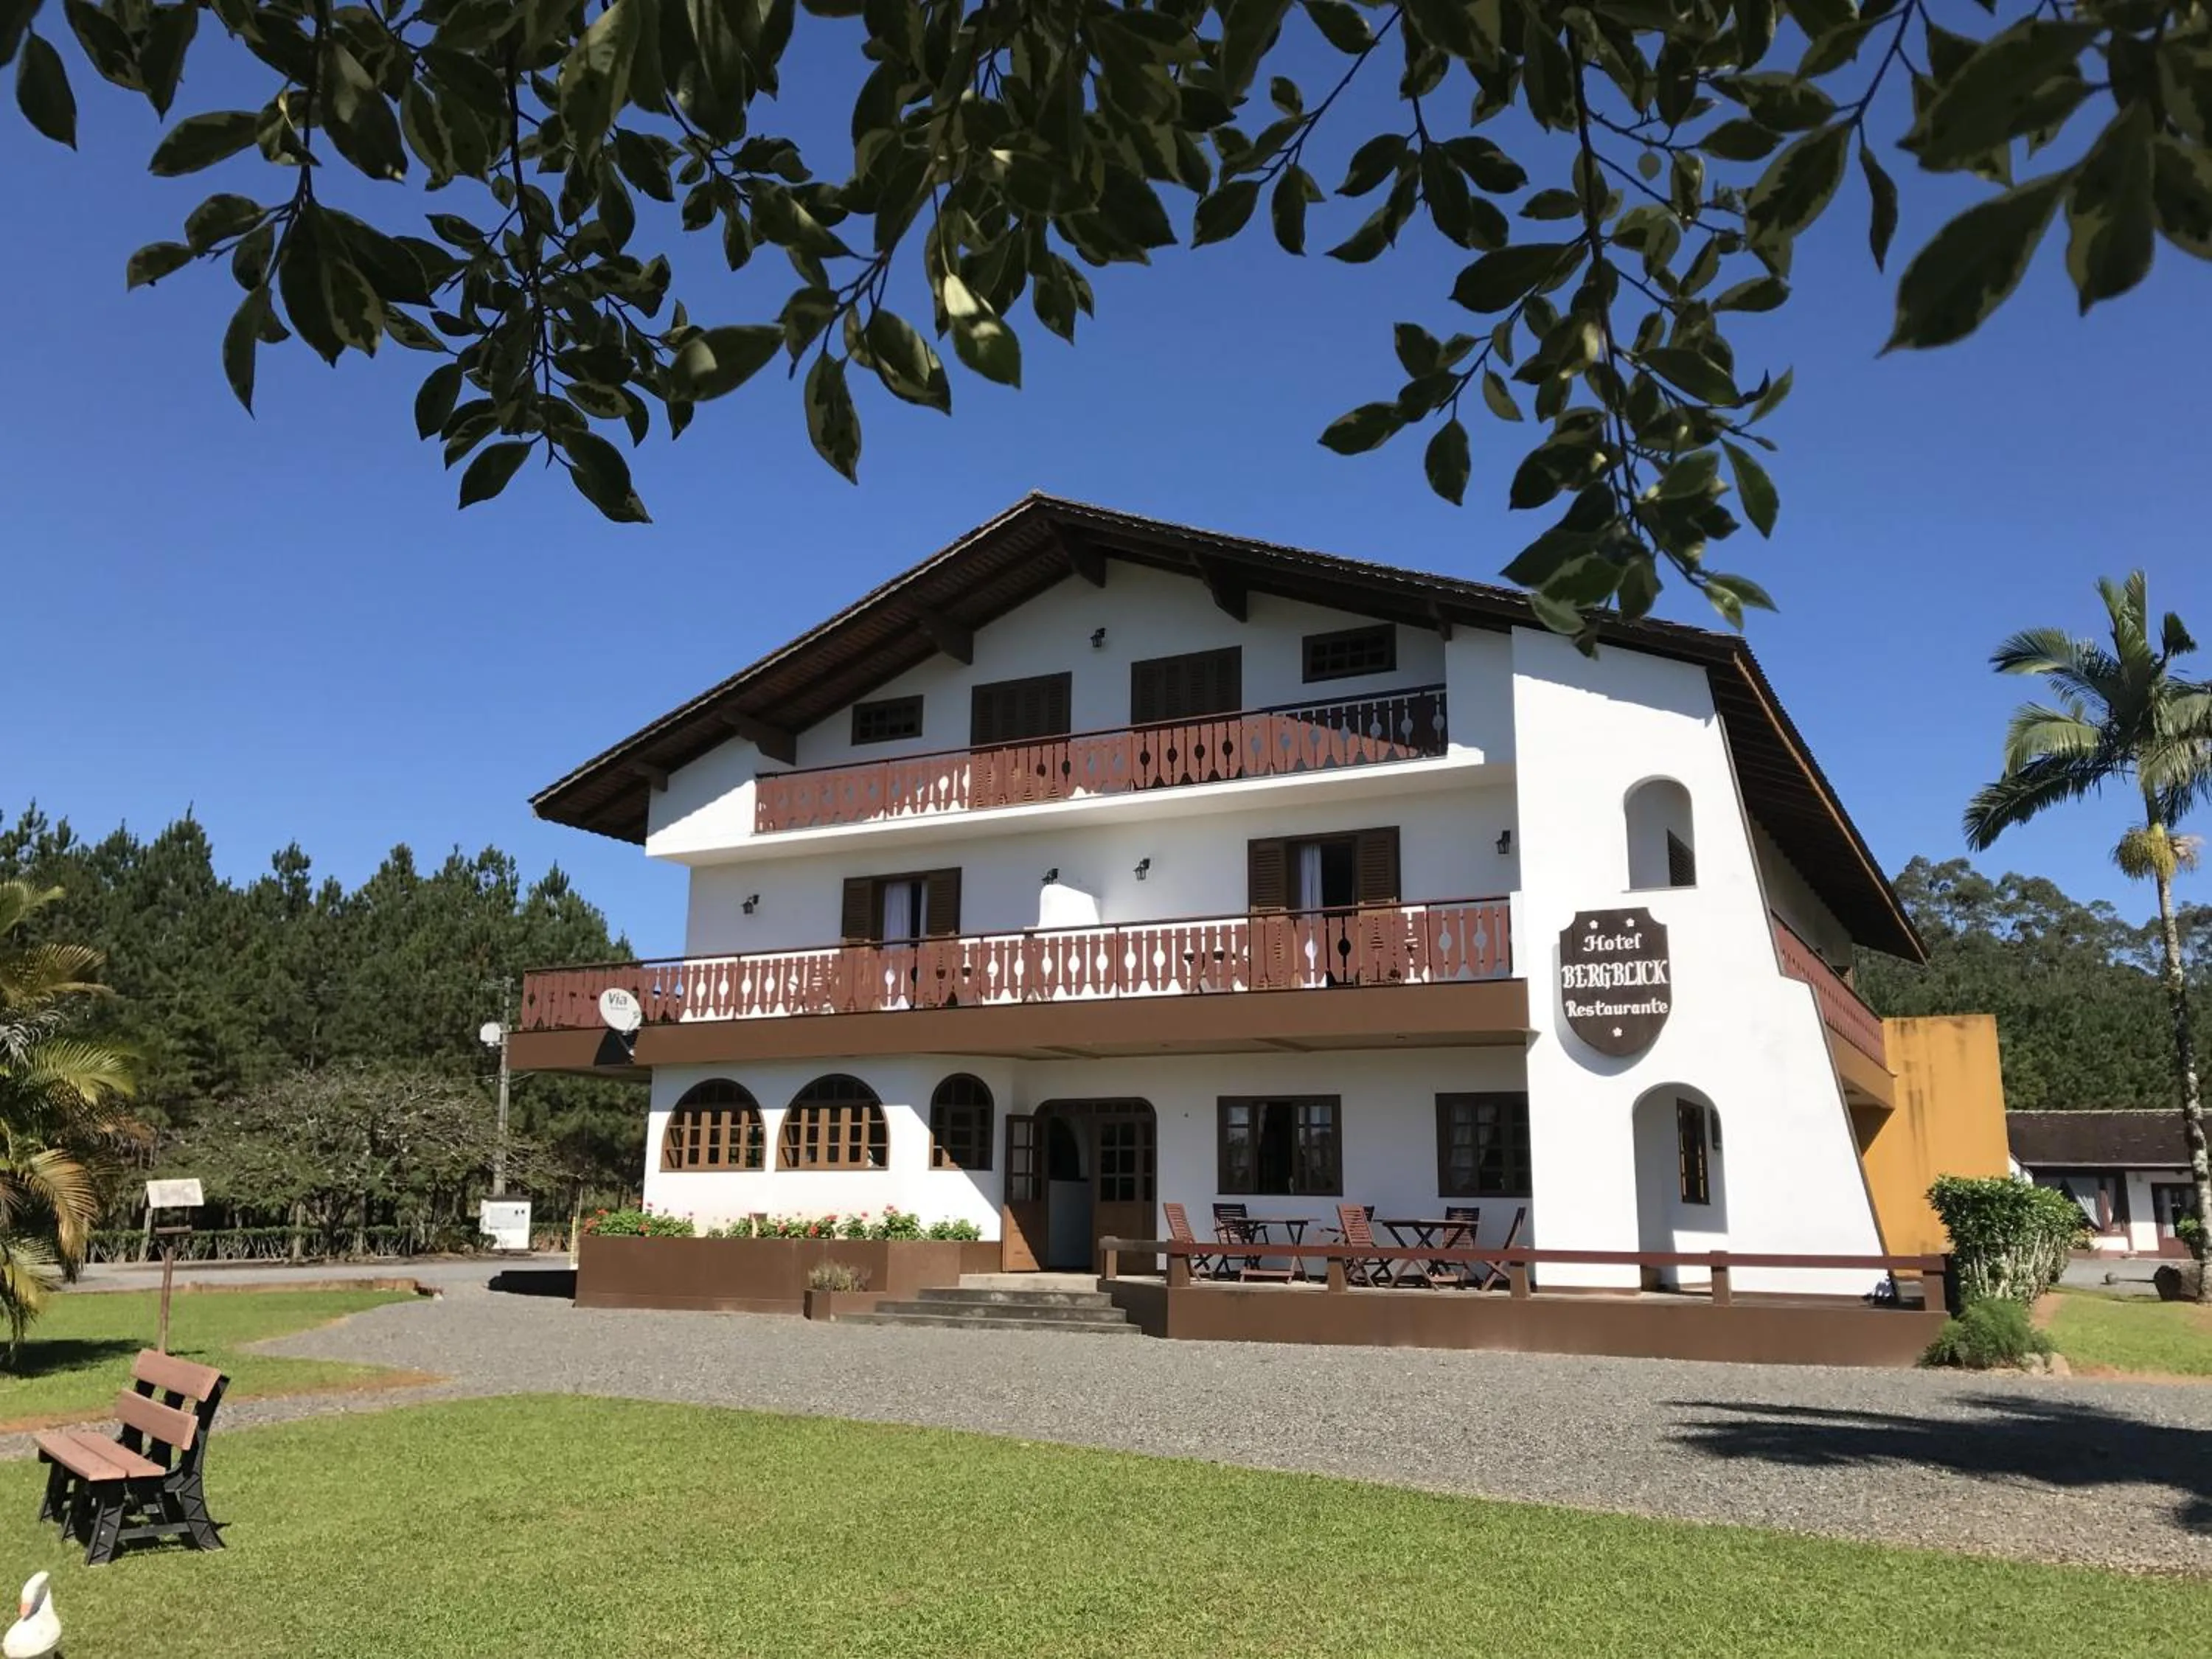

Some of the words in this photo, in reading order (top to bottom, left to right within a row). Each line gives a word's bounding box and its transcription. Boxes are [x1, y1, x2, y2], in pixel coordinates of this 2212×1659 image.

[1582, 933, 1642, 952] Hotel
[1561, 959, 1669, 990] BERGBLICK
[1565, 998, 1669, 1018] Restaurante
